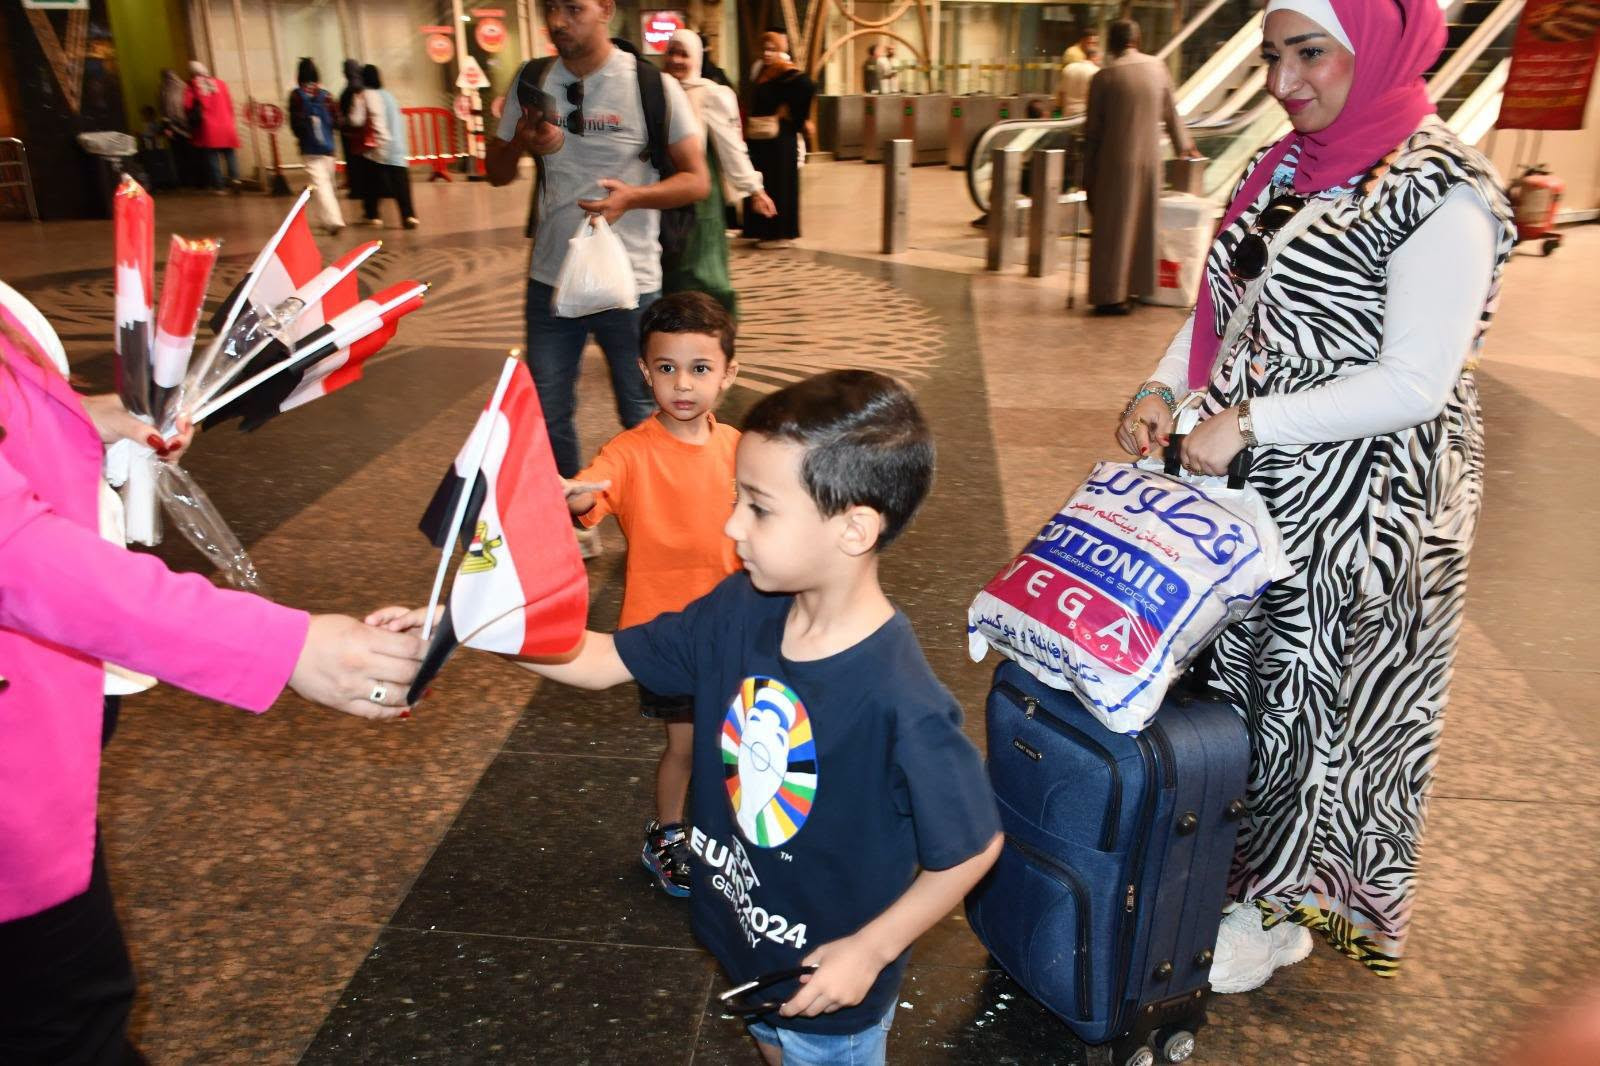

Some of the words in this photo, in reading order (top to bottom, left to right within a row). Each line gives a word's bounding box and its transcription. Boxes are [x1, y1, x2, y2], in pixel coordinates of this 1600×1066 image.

[1086, 469, 1245, 566] قطوني
[1094, 510, 1138, 535] بيتكلم
[1135, 530, 1180, 562] القطن
[1049, 546, 1106, 579] UNDERWEAR
[1116, 582, 1158, 613] SOCKS
[1002, 559, 1132, 655] VEGA
[780, 851, 793, 862] TM
